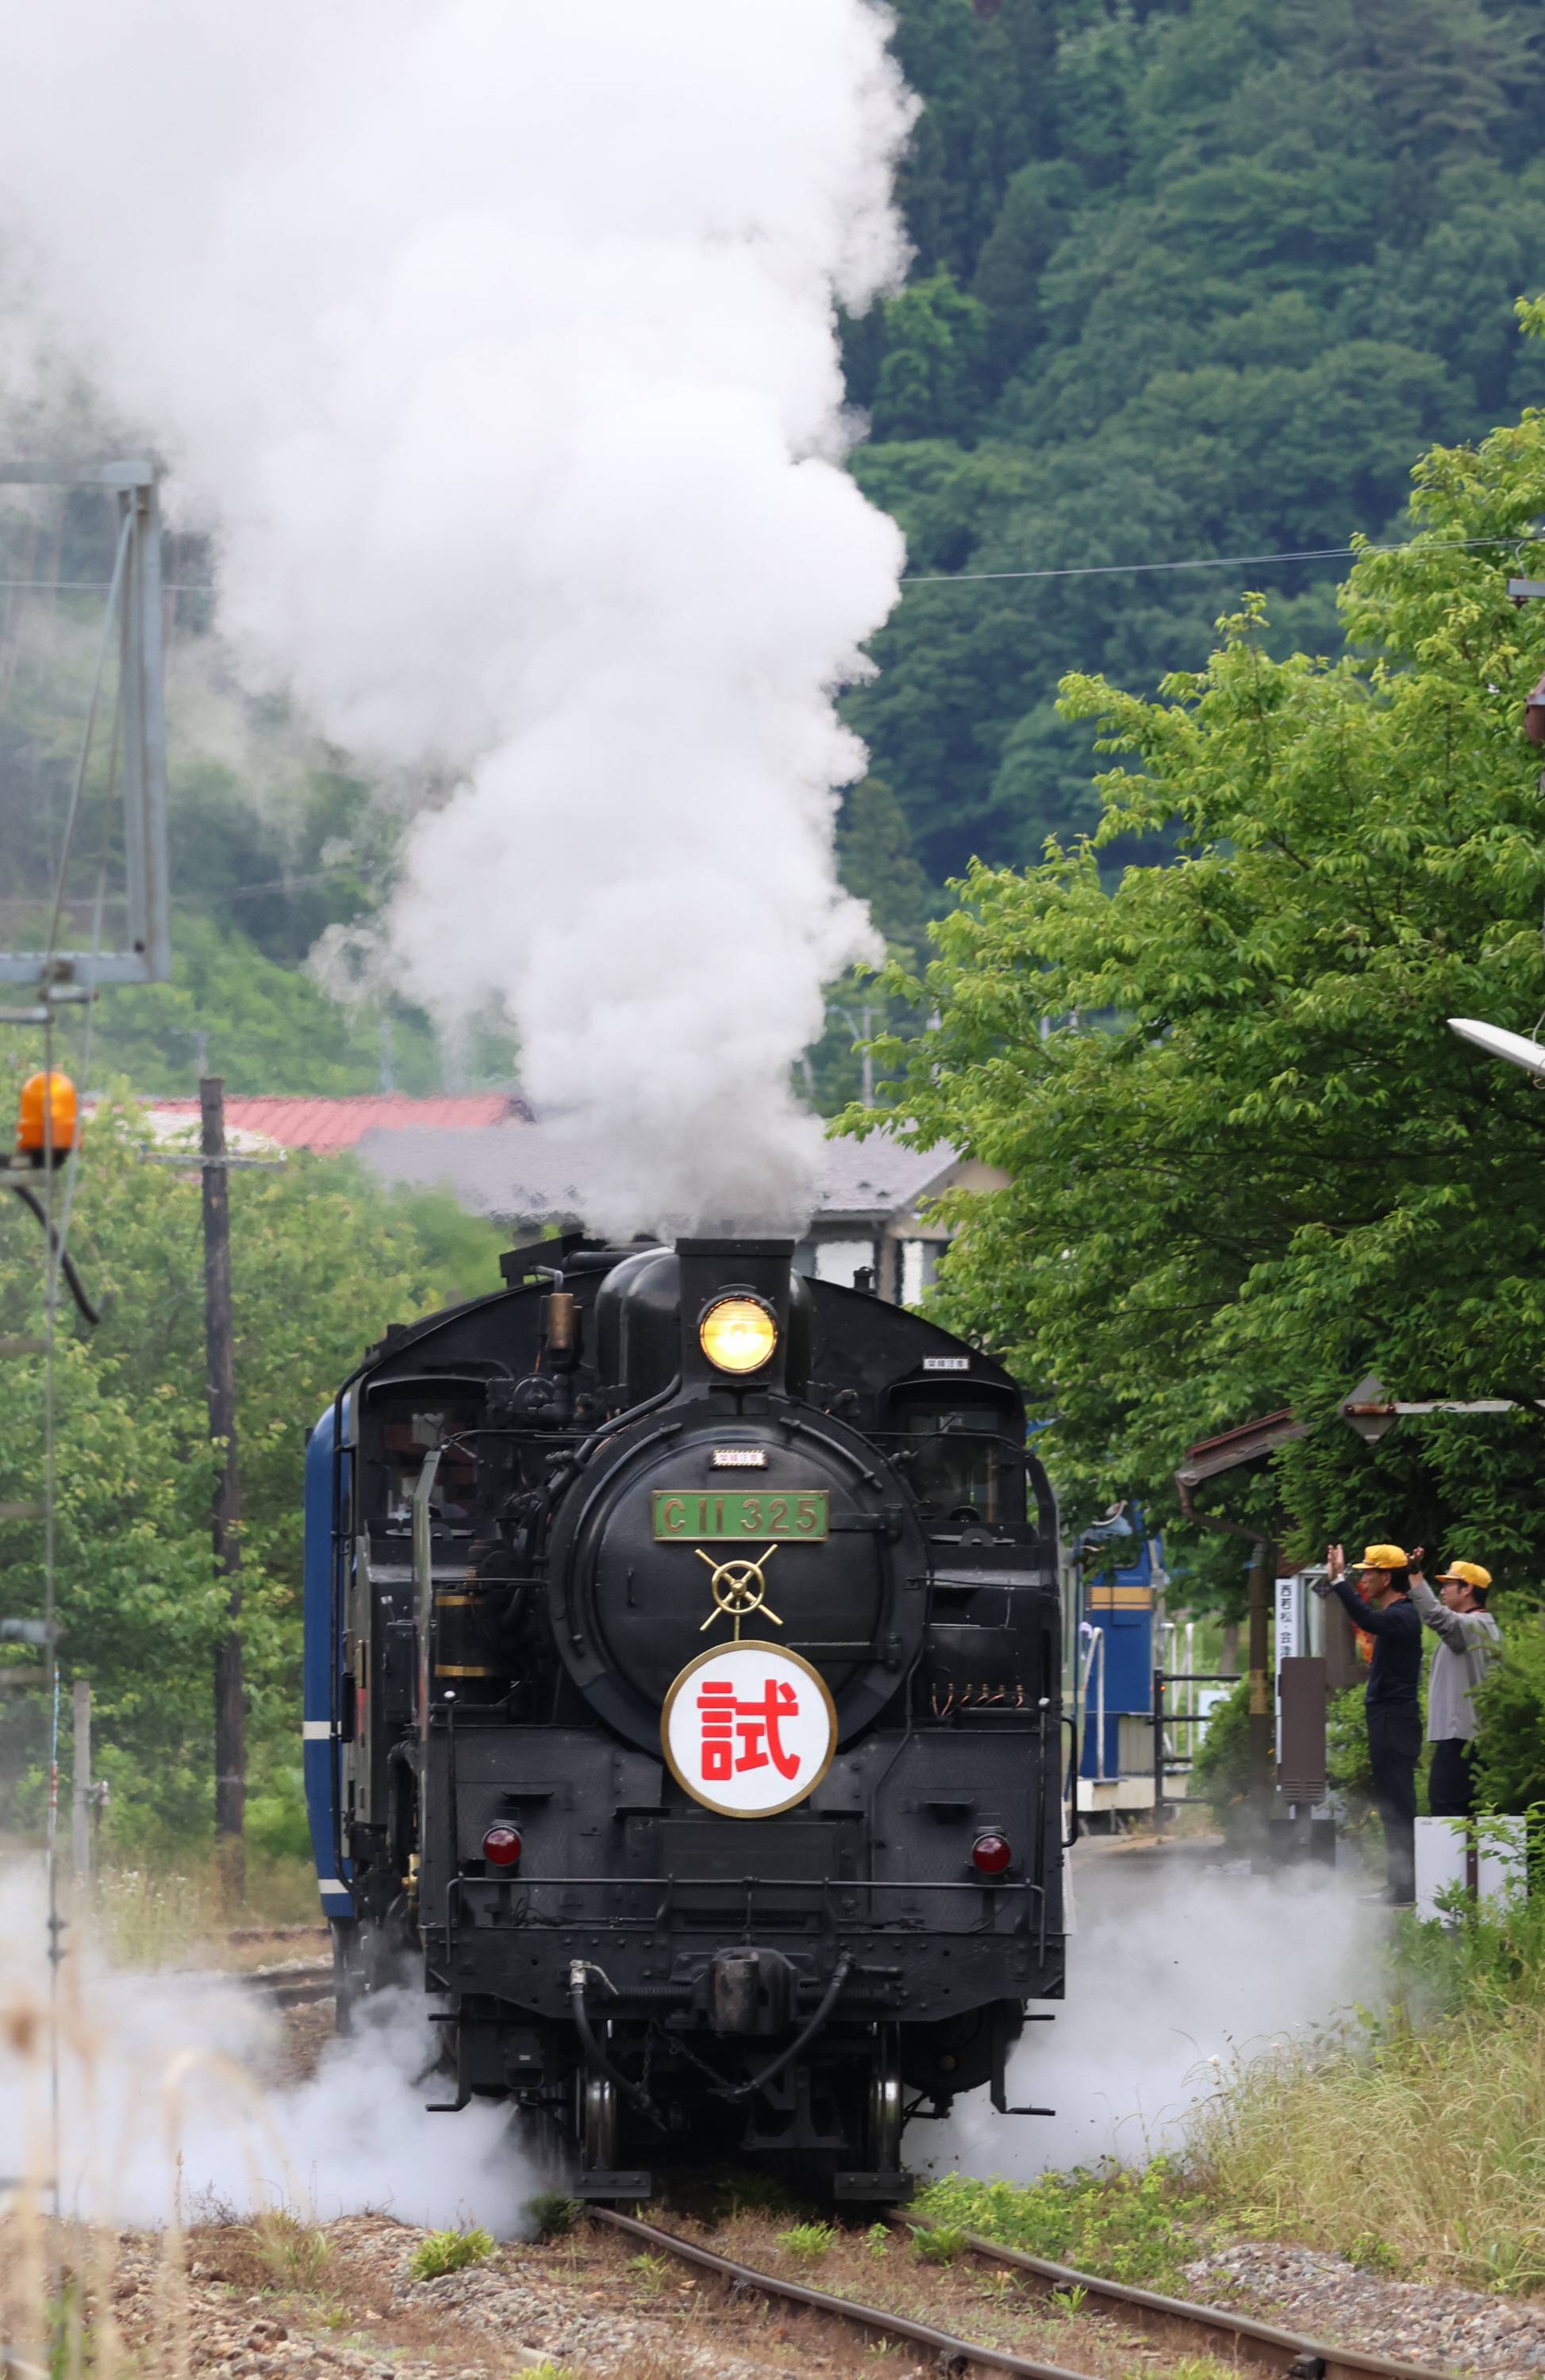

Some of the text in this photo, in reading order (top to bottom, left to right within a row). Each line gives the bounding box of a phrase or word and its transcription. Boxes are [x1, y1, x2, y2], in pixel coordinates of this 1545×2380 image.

[663, 1498, 818, 1534] C11 325
[697, 1679, 801, 1781] 試
